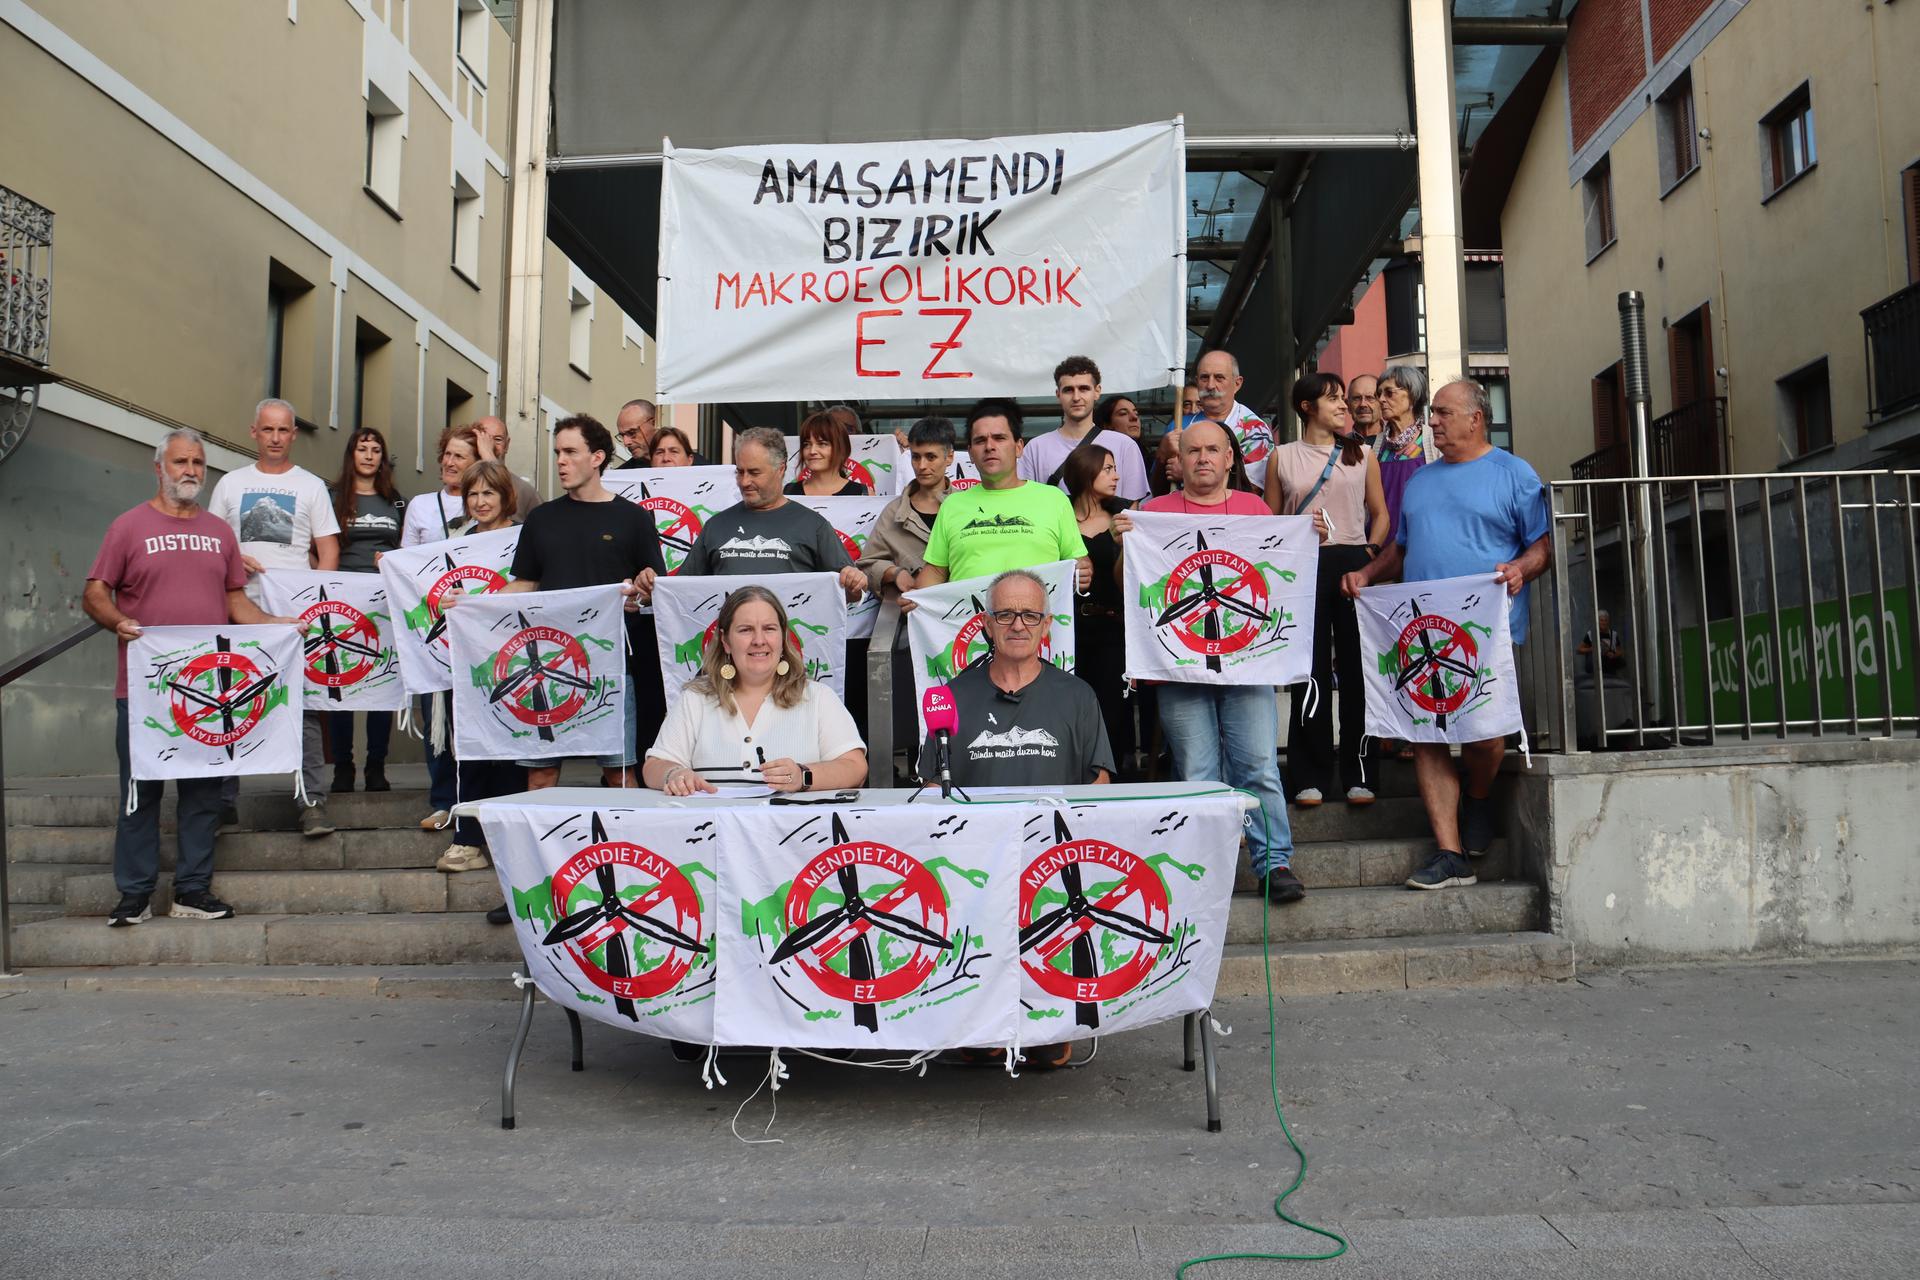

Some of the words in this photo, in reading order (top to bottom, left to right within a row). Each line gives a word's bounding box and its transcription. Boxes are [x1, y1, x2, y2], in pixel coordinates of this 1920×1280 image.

[753, 148, 1065, 209] AMASAMENDI
[823, 208, 1003, 264] BIZIRIK
[855, 308, 974, 380] EZ
[643, 501, 686, 516] DIETAN
[144, 533, 222, 554] DISTORT
[1177, 553, 1249, 579] MENDIETAN
[433, 567, 494, 598] MENDIETAN
[1402, 617, 1457, 646] MENDIETAN
[504, 629, 572, 656] MENDIETAN
[1206, 642, 1221, 652] EZ
[216, 654, 231, 665] EZ
[328, 676, 341, 685] EZ
[926, 703, 952, 713] KANALA
[1435, 702, 1447, 711] EZ
[537, 713, 551, 723] EZ
[189, 717, 254, 744] MENDIETAN
[970, 748, 994, 760] Zaindu
[995, 748, 1016, 758] maite
[1016, 745, 1041, 756] duzun
[1041, 745, 1057, 758] hori
[562, 847, 671, 885] MENDIETAN
[802, 846, 915, 889] MENDIETAN
[1025, 844, 1137, 889] MENDIETAN
[613, 980, 633, 995] EZ
[854, 984, 876, 999] EZ
[1077, 982, 1099, 998] EZ
